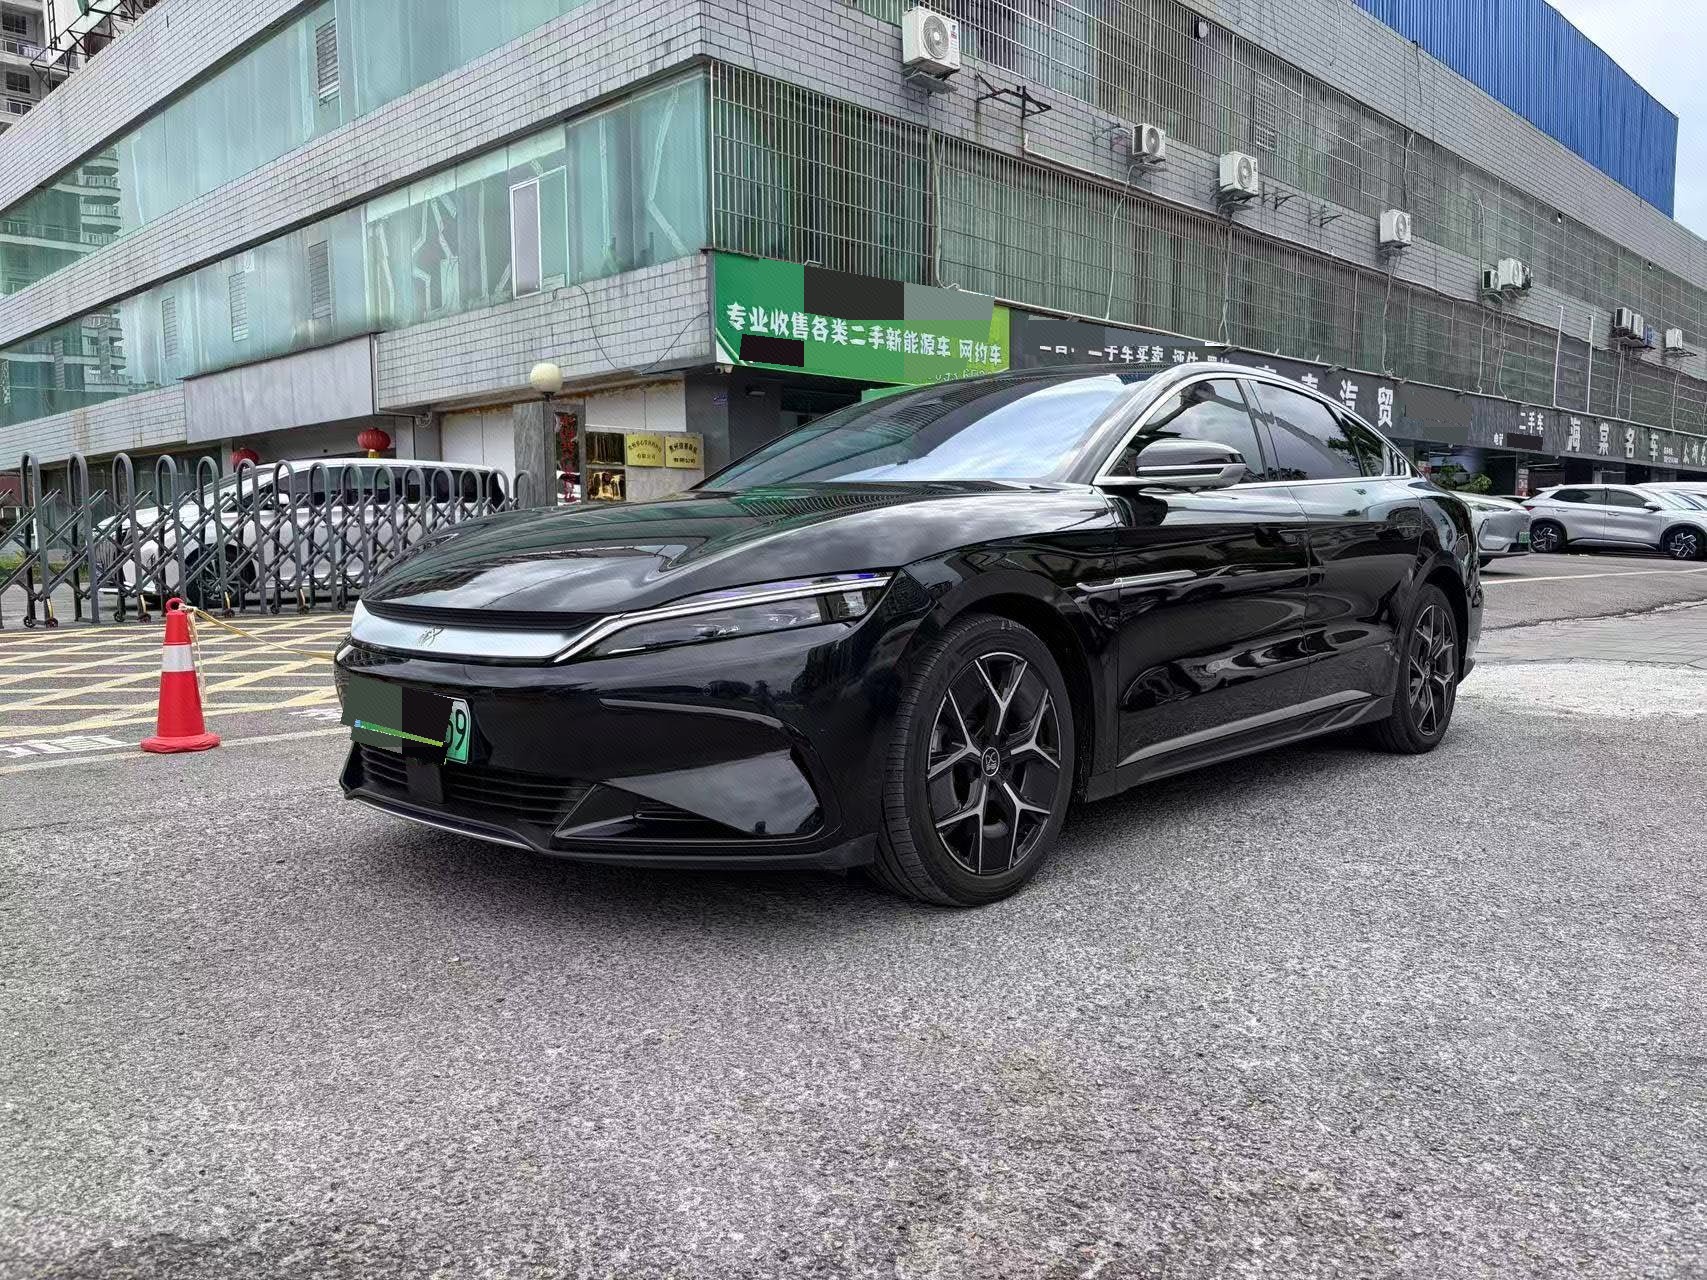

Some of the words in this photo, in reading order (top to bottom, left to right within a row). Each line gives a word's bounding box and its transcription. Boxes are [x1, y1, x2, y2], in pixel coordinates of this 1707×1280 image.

[726, 301, 951, 358] 专业收售各类二手新能源车
[959, 340, 1003, 367] 网约车
[1519, 411, 1545, 435] 二手车
